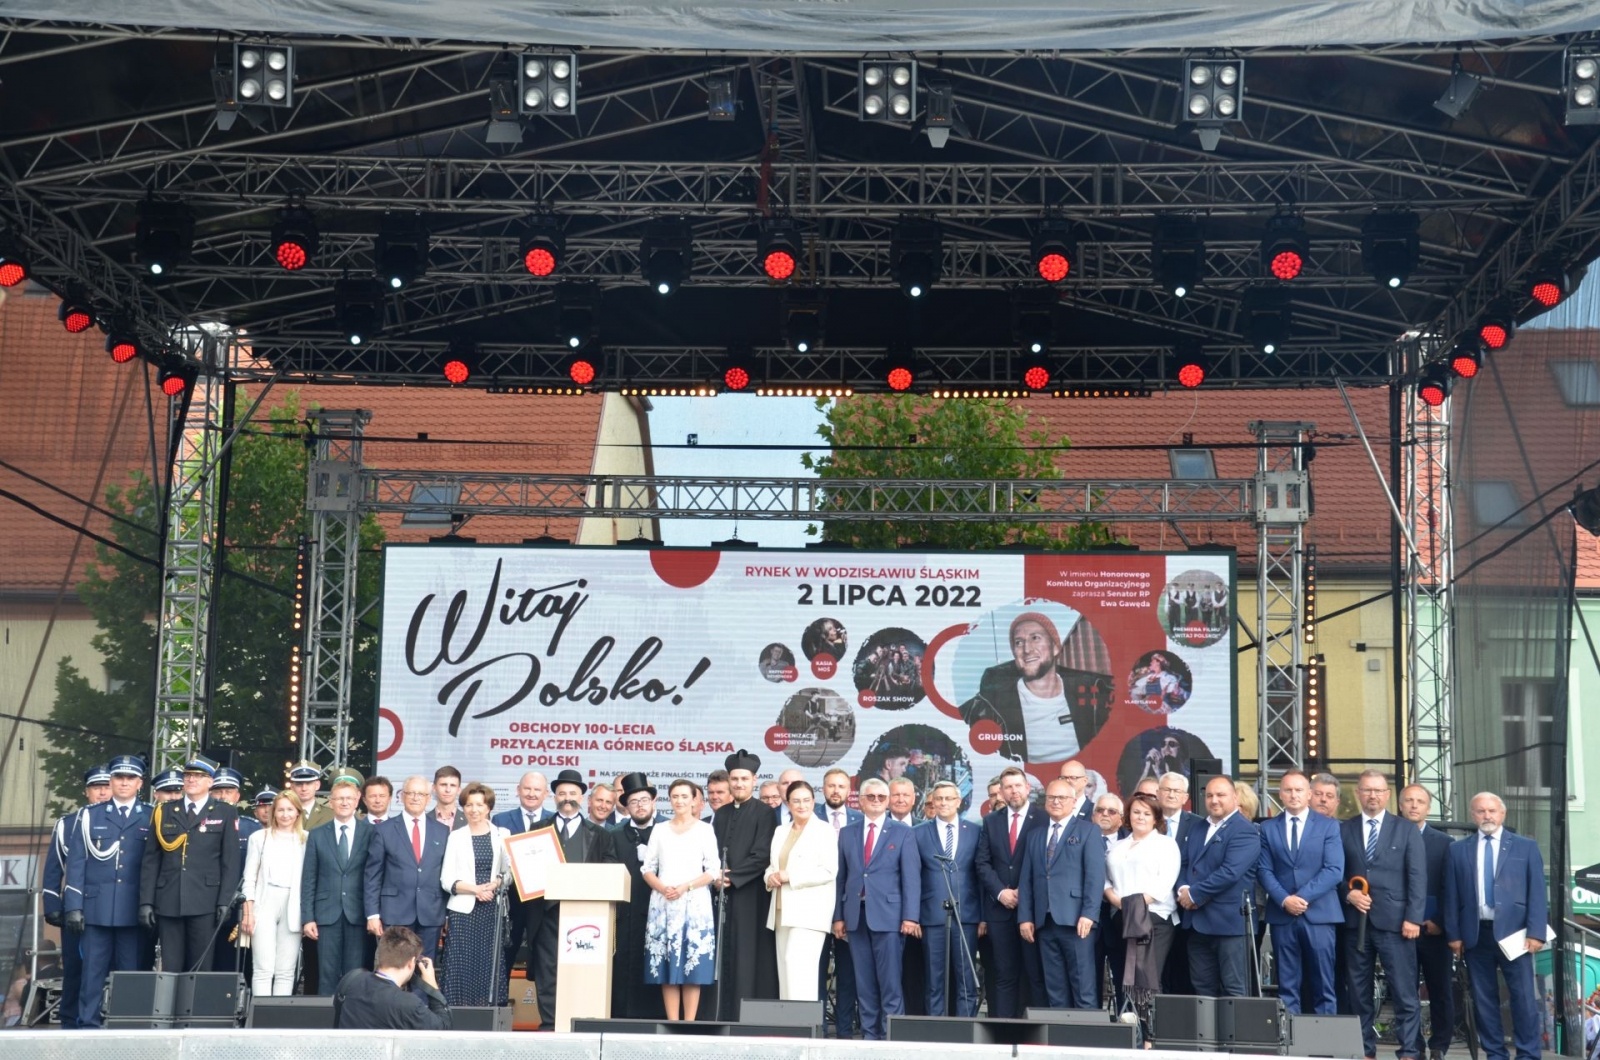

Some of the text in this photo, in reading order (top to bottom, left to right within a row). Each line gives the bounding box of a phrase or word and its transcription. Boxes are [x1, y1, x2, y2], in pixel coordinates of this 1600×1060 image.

[745, 566, 979, 581] RYNEK W WODZISŁAWIU ŚLĄSKIM
[1100, 571, 1150, 579] Honorowego
[1084, 580, 1150, 588] Organizacyjnego
[797, 583, 982, 607] 2 LIPCA 2022
[1119, 600, 1150, 608] Gawęda
[405, 557, 589, 676] Witaj
[437, 635, 711, 738] Polsko!
[509, 722, 656, 735] OBCHODY 100-LECIA
[978, 733, 1023, 741] GRUBSON
[490, 738, 735, 755] PRZYŁĄCZENIA GÓRNEGO ŚLĄSKA
[502, 755, 579, 767] DO POLSKI
